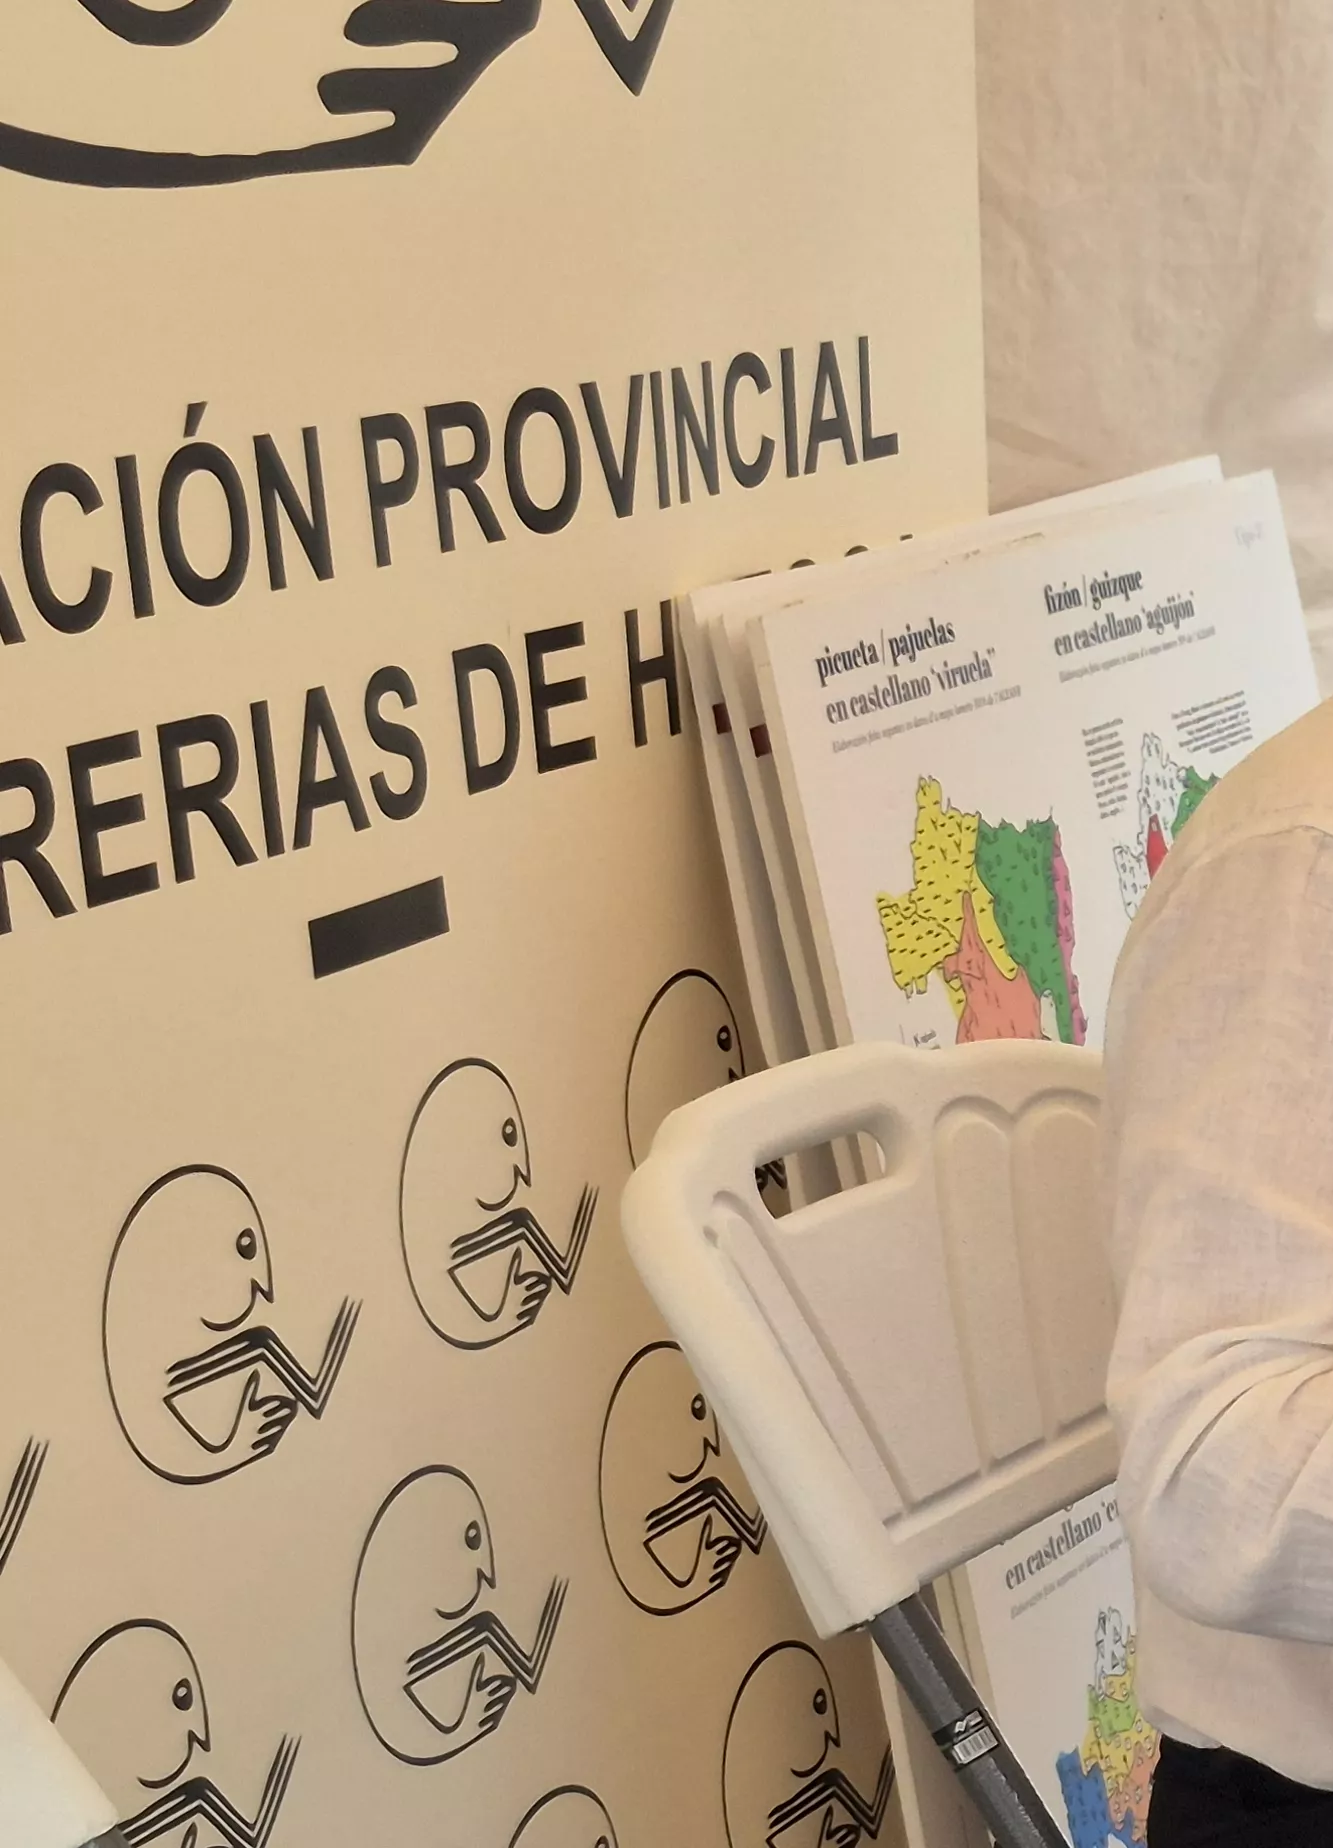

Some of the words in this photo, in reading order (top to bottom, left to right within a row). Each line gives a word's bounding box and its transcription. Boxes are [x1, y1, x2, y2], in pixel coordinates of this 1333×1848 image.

[0, 402, 334, 646] CIÓN
[358, 334, 900, 568] PROVINCIAL
[1044, 581, 1082, 615] fizón
[1089, 569, 1144, 610] guizque
[815, 639, 879, 688] picueta
[888, 616, 956, 667] pajuelas
[1054, 632, 1074, 656] en
[1074, 612, 1143, 652] castellano
[826, 699, 849, 724] en
[850, 672, 932, 717] castellano
[0, 665, 428, 936] RERIAS
[452, 619, 597, 796] DE
[1005, 1562, 1026, 1590] en
[1026, 1511, 1102, 1576] castellano
